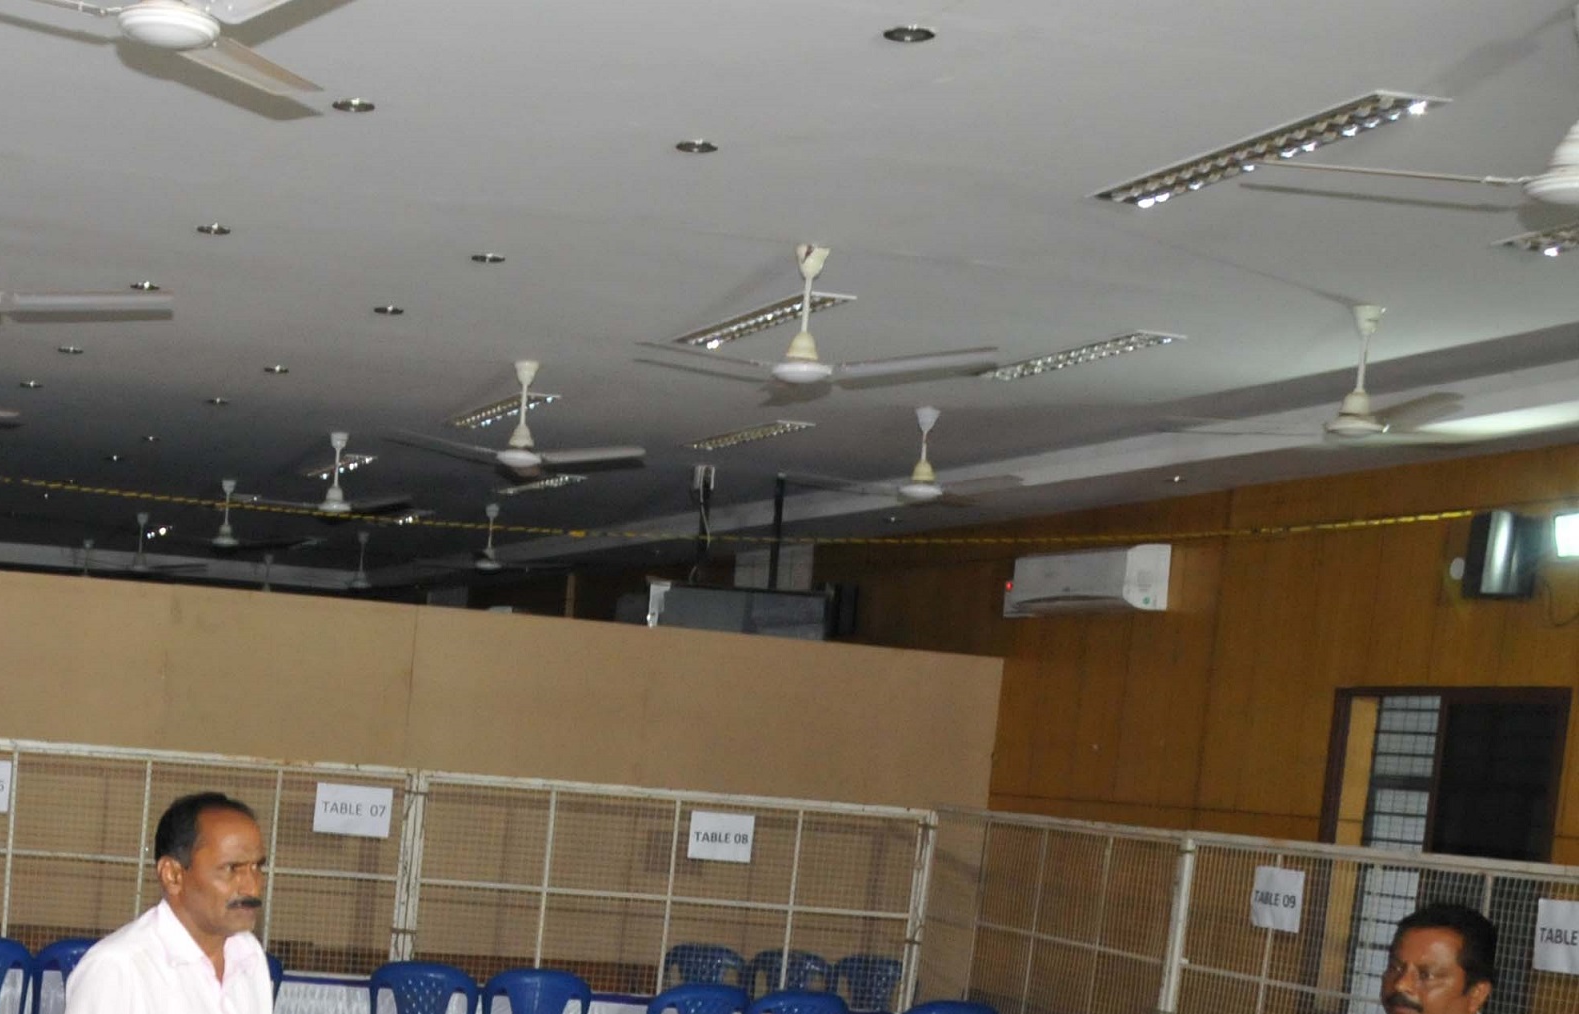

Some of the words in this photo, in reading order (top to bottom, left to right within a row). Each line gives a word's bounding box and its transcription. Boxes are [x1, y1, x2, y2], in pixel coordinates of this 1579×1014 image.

[322, 800, 362, 816] TABLE
[369, 804, 387, 818] 07
[693, 831, 731, 844] TABLE
[1254, 889, 1280, 907] TABLE
[1282, 893, 1297, 909] 09
[1540, 927, 1578, 946] TABLE
